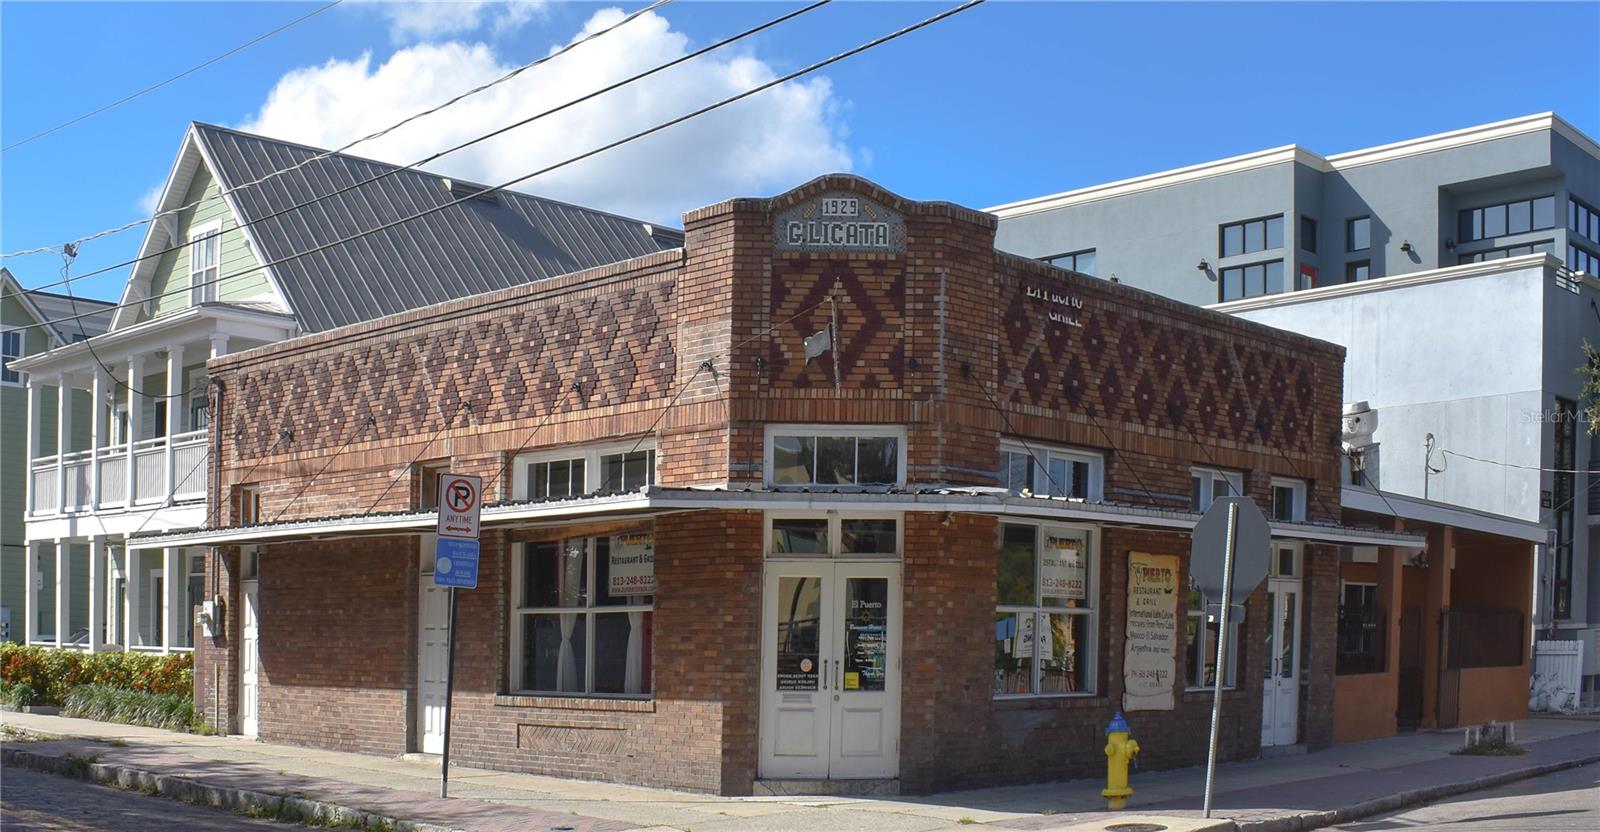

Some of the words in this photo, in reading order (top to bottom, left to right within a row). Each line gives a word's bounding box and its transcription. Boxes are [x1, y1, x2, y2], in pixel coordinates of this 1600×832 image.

[824, 200, 857, 214] 1929
[446, 514, 473, 525] ANYTIME
[852, 600, 859, 609] El
[860, 600, 882, 609] Puerto
